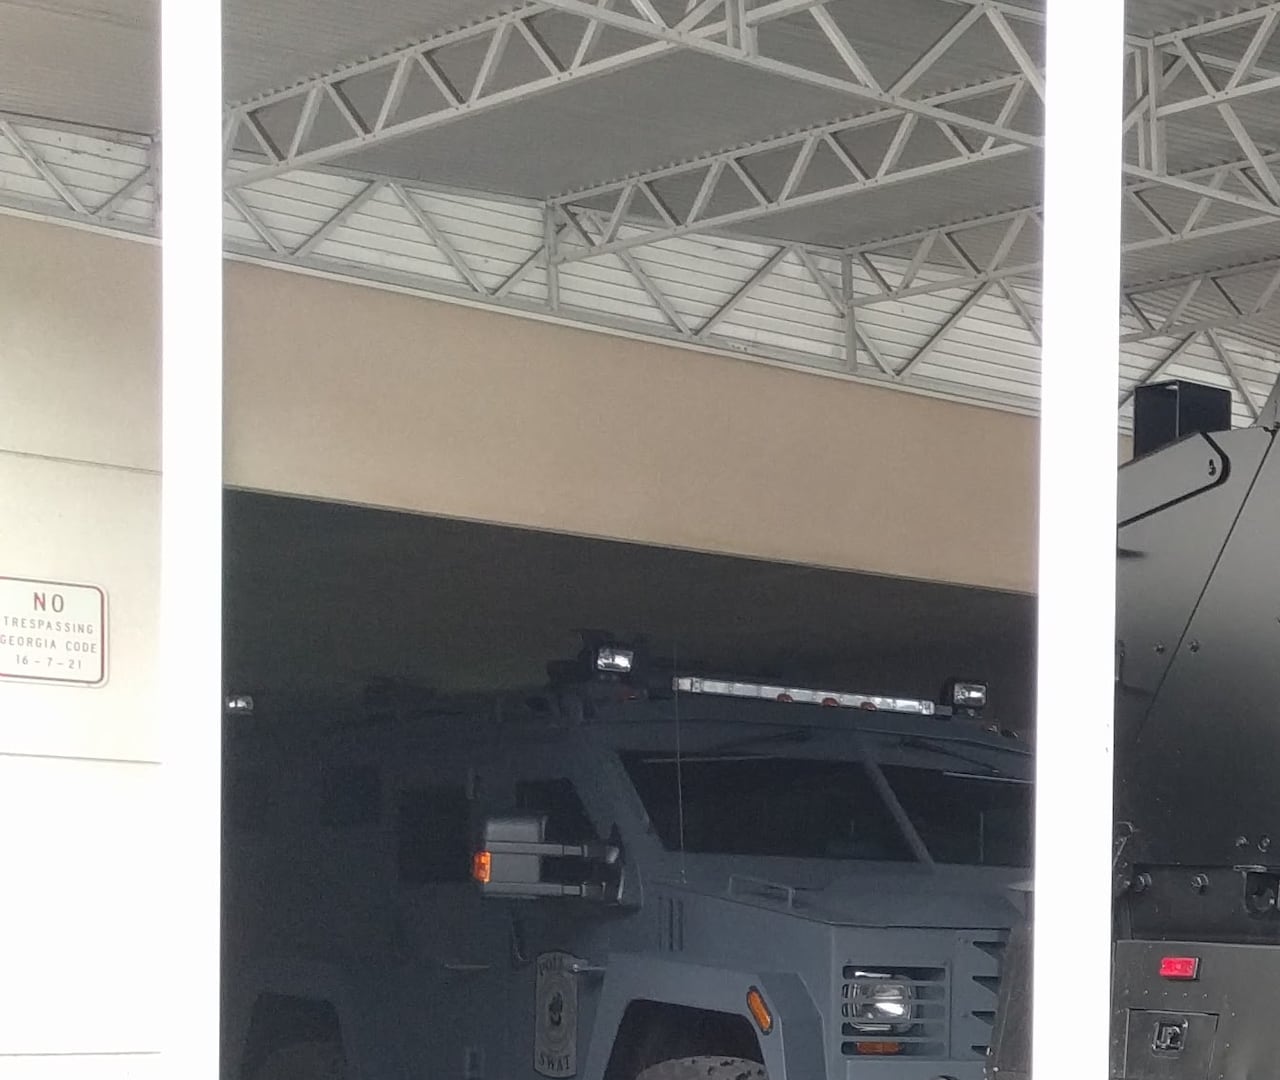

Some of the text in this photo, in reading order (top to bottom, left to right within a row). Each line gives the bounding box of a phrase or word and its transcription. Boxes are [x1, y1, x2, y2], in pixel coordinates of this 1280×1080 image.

[33, 592, 65, 613] NO
[4, 616, 94, 634] TRESPASSING
[0, 634, 97, 653] GEORGIA CODE
[538, 1052, 570, 1072] SWAT
